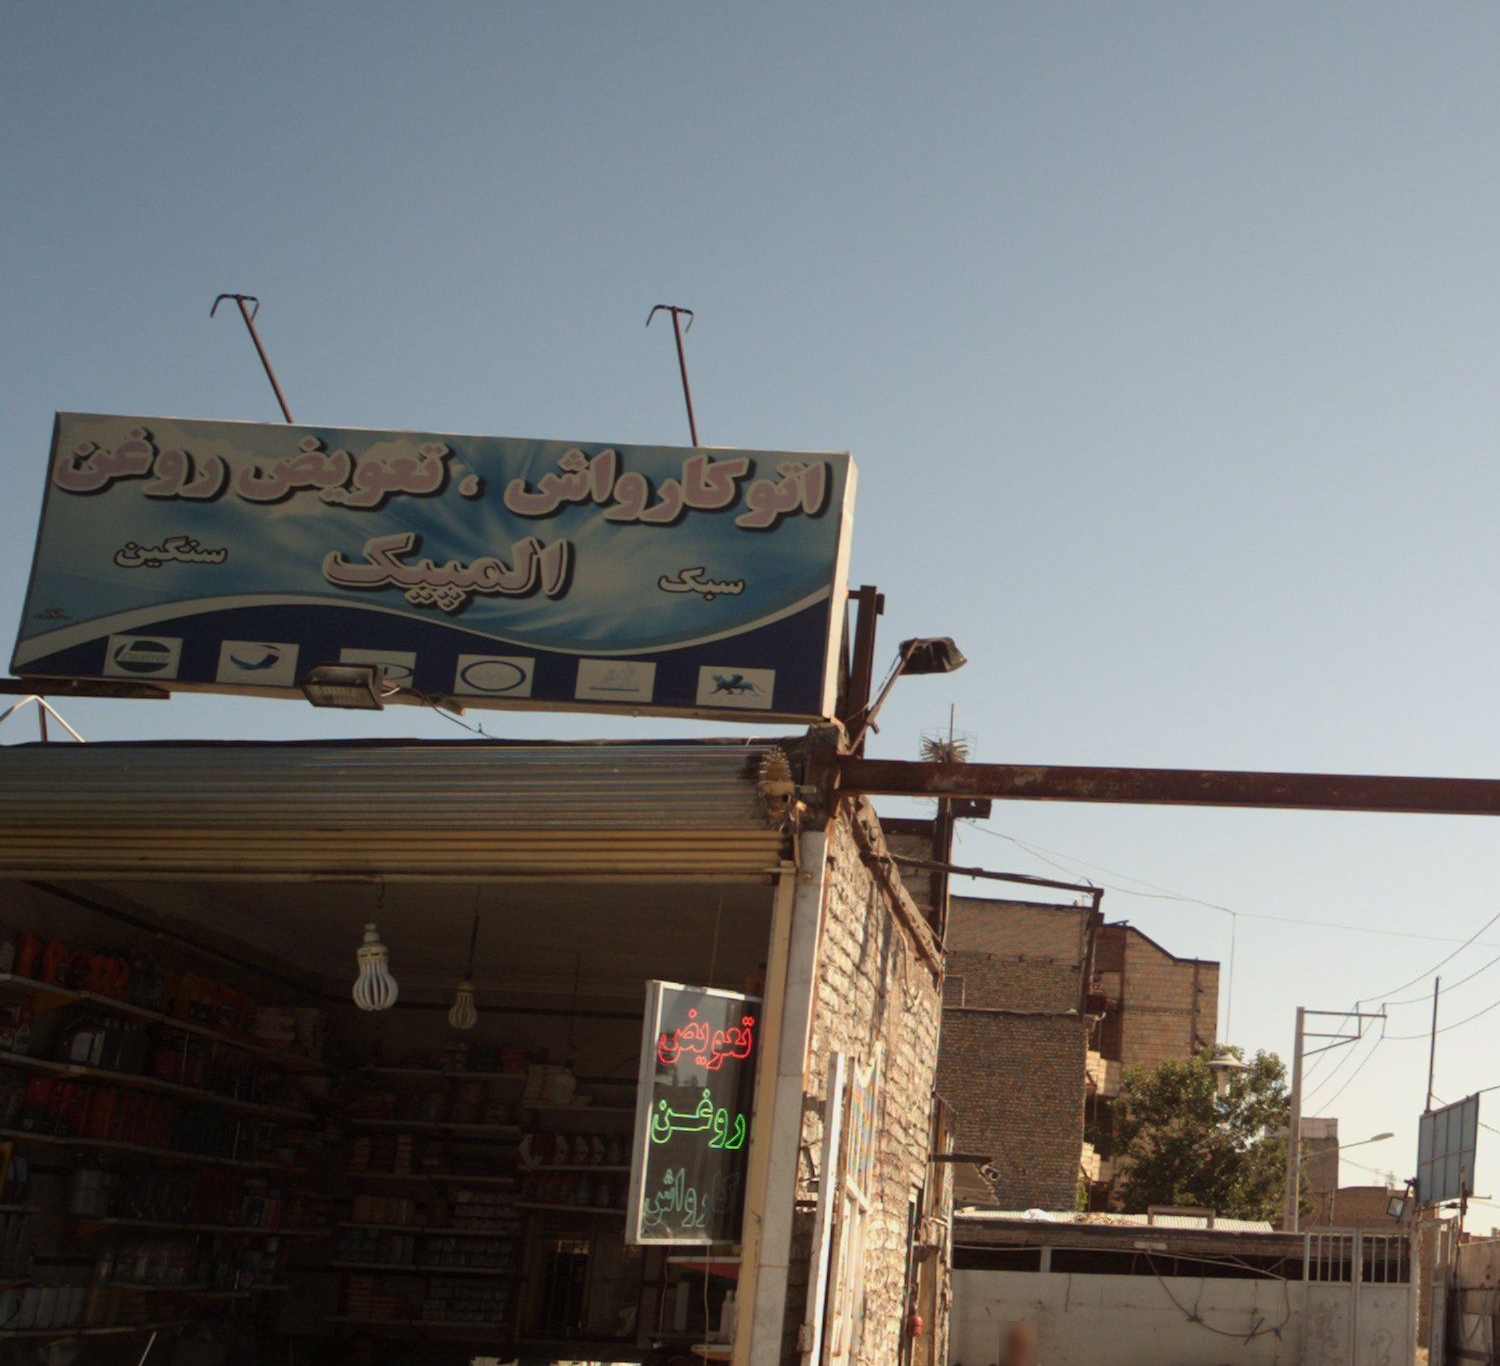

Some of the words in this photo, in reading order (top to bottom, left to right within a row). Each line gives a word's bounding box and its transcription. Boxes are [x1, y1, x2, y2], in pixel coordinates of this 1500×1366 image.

[52, 427, 228, 500] روغن
[236, 434, 450, 509] تعویض
[113, 535, 230, 569] سنگین
[321, 532, 570, 613] المپیک
[656, 566, 747, 602] سبک
[656, 1008, 756, 1071] تعویض
[649, 1087, 747, 1150] روغن
[643, 1167, 740, 1228] کارواش
